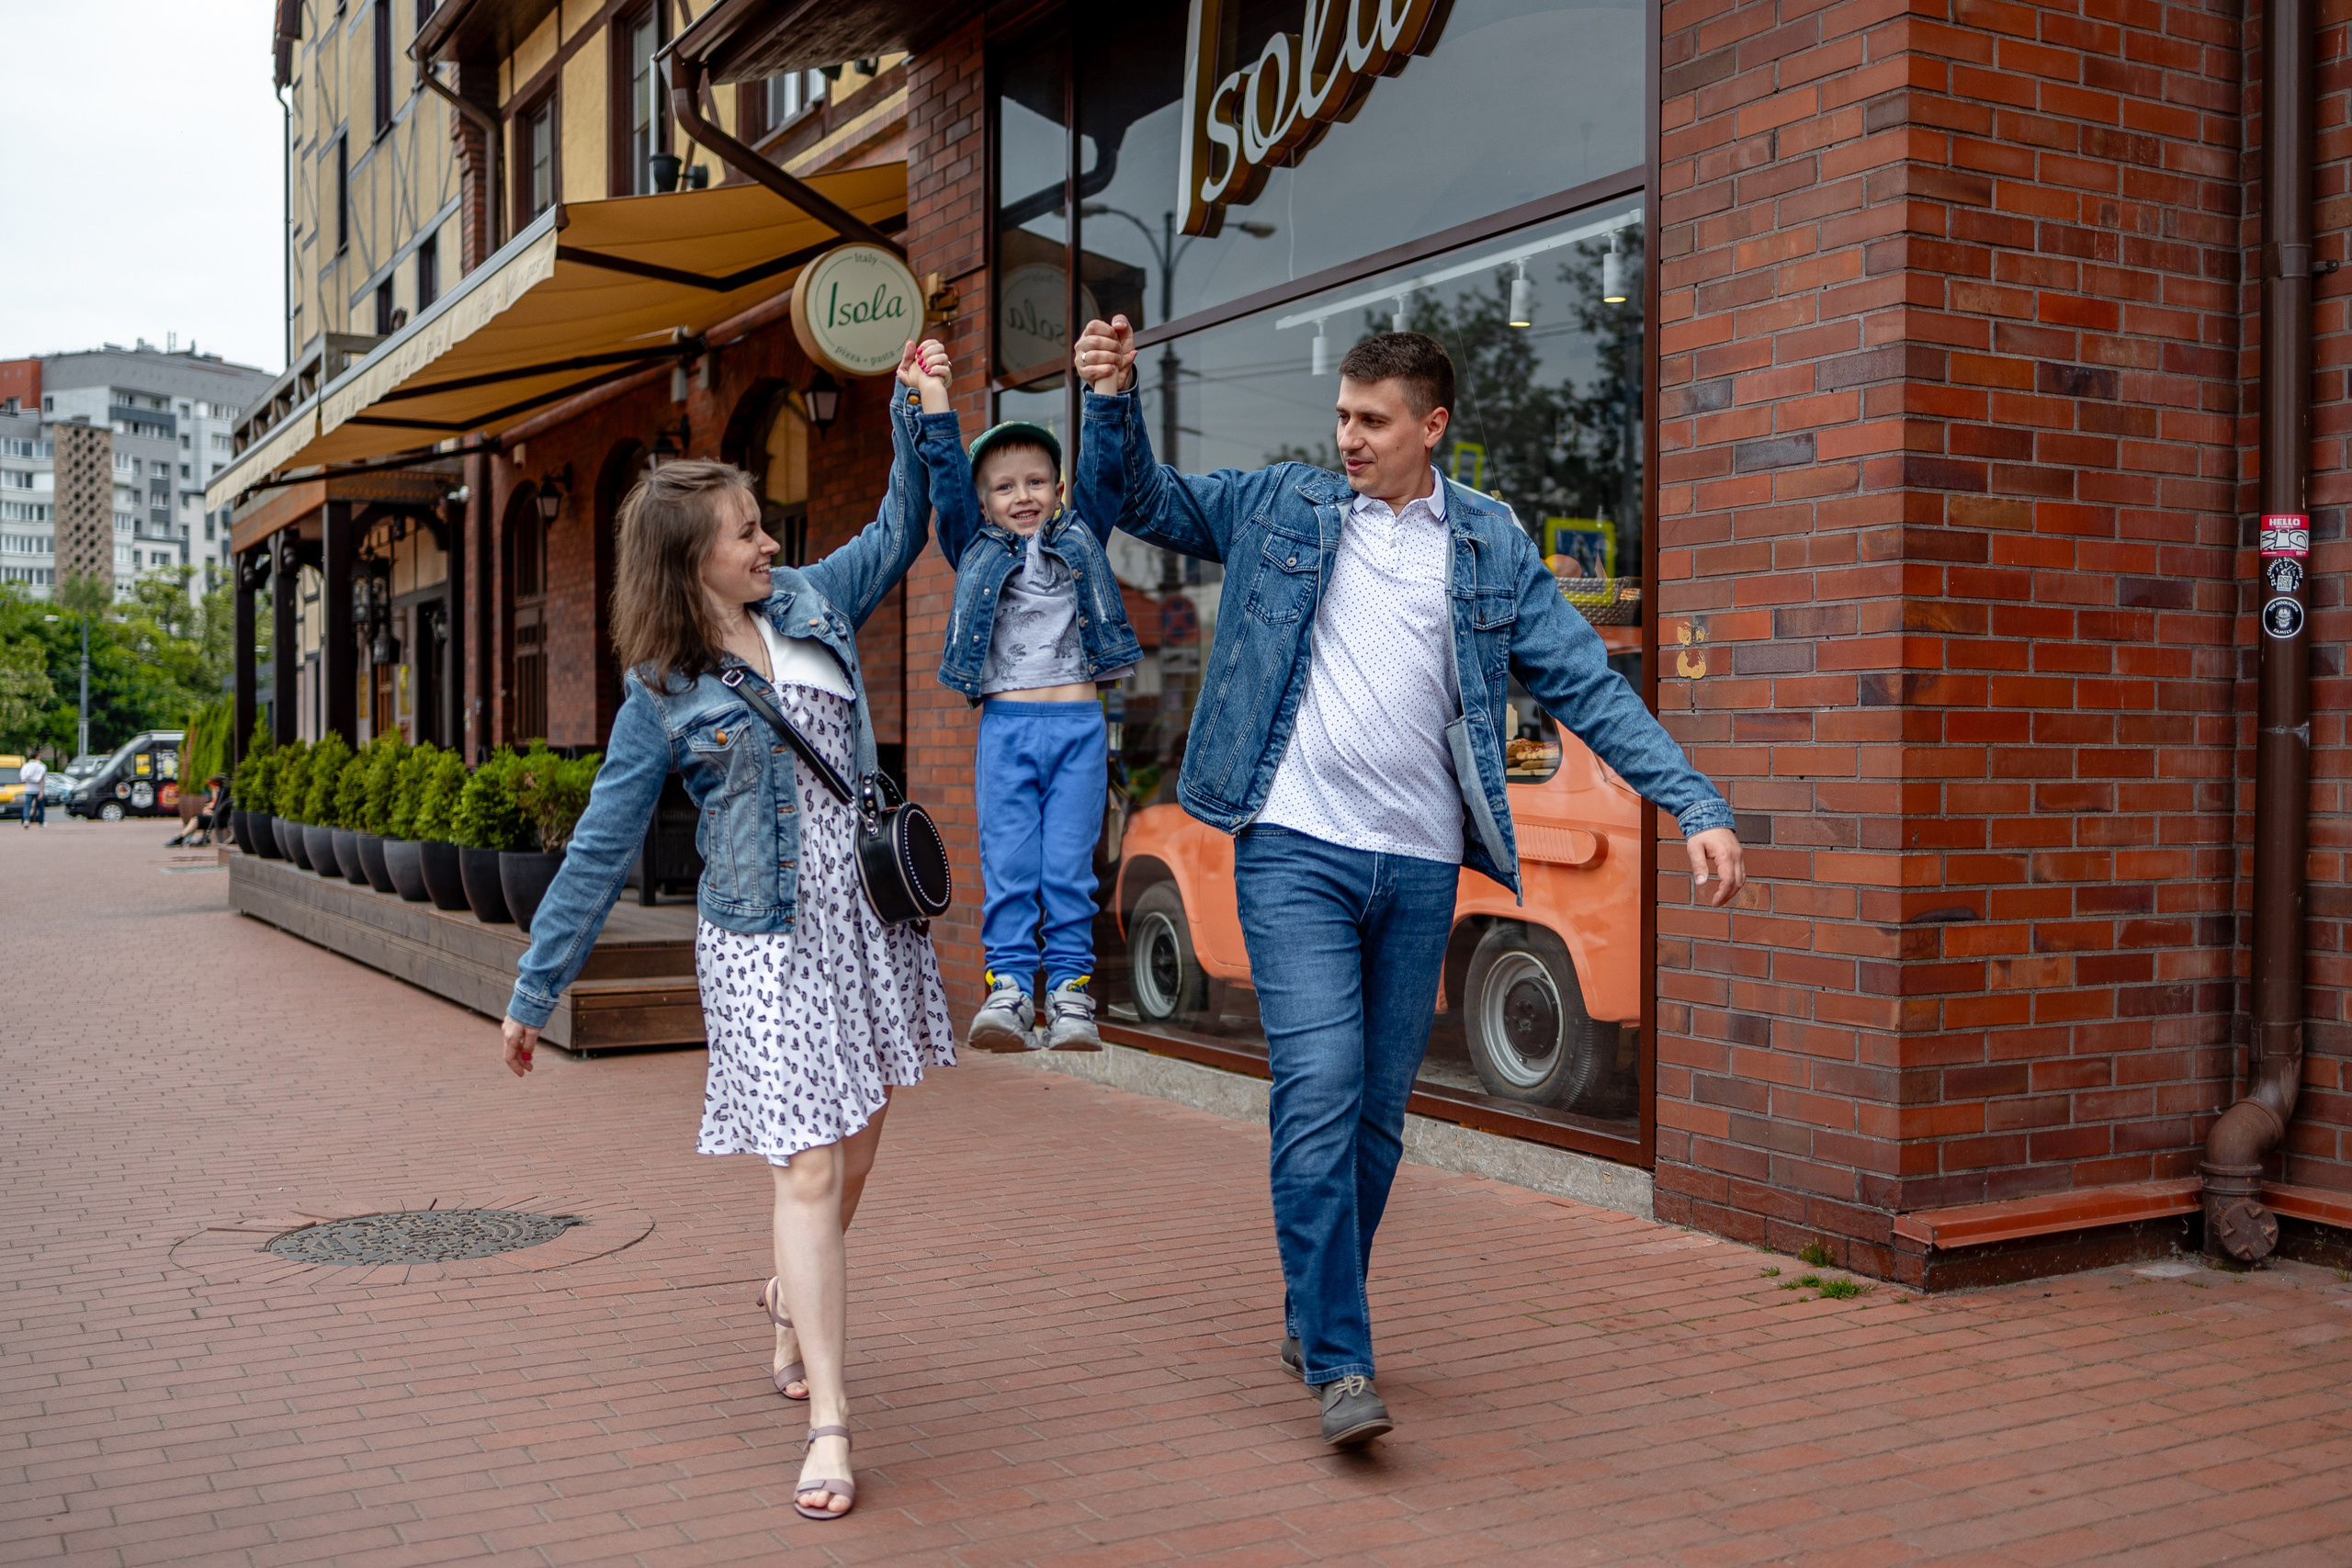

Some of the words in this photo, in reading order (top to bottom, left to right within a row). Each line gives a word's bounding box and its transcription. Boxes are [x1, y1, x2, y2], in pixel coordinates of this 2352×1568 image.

[854, 252, 878, 266] Italy
[828, 281, 907, 329] Isola
[834, 345, 861, 363] pizza
[2269, 518, 2301, 526] HELLO
